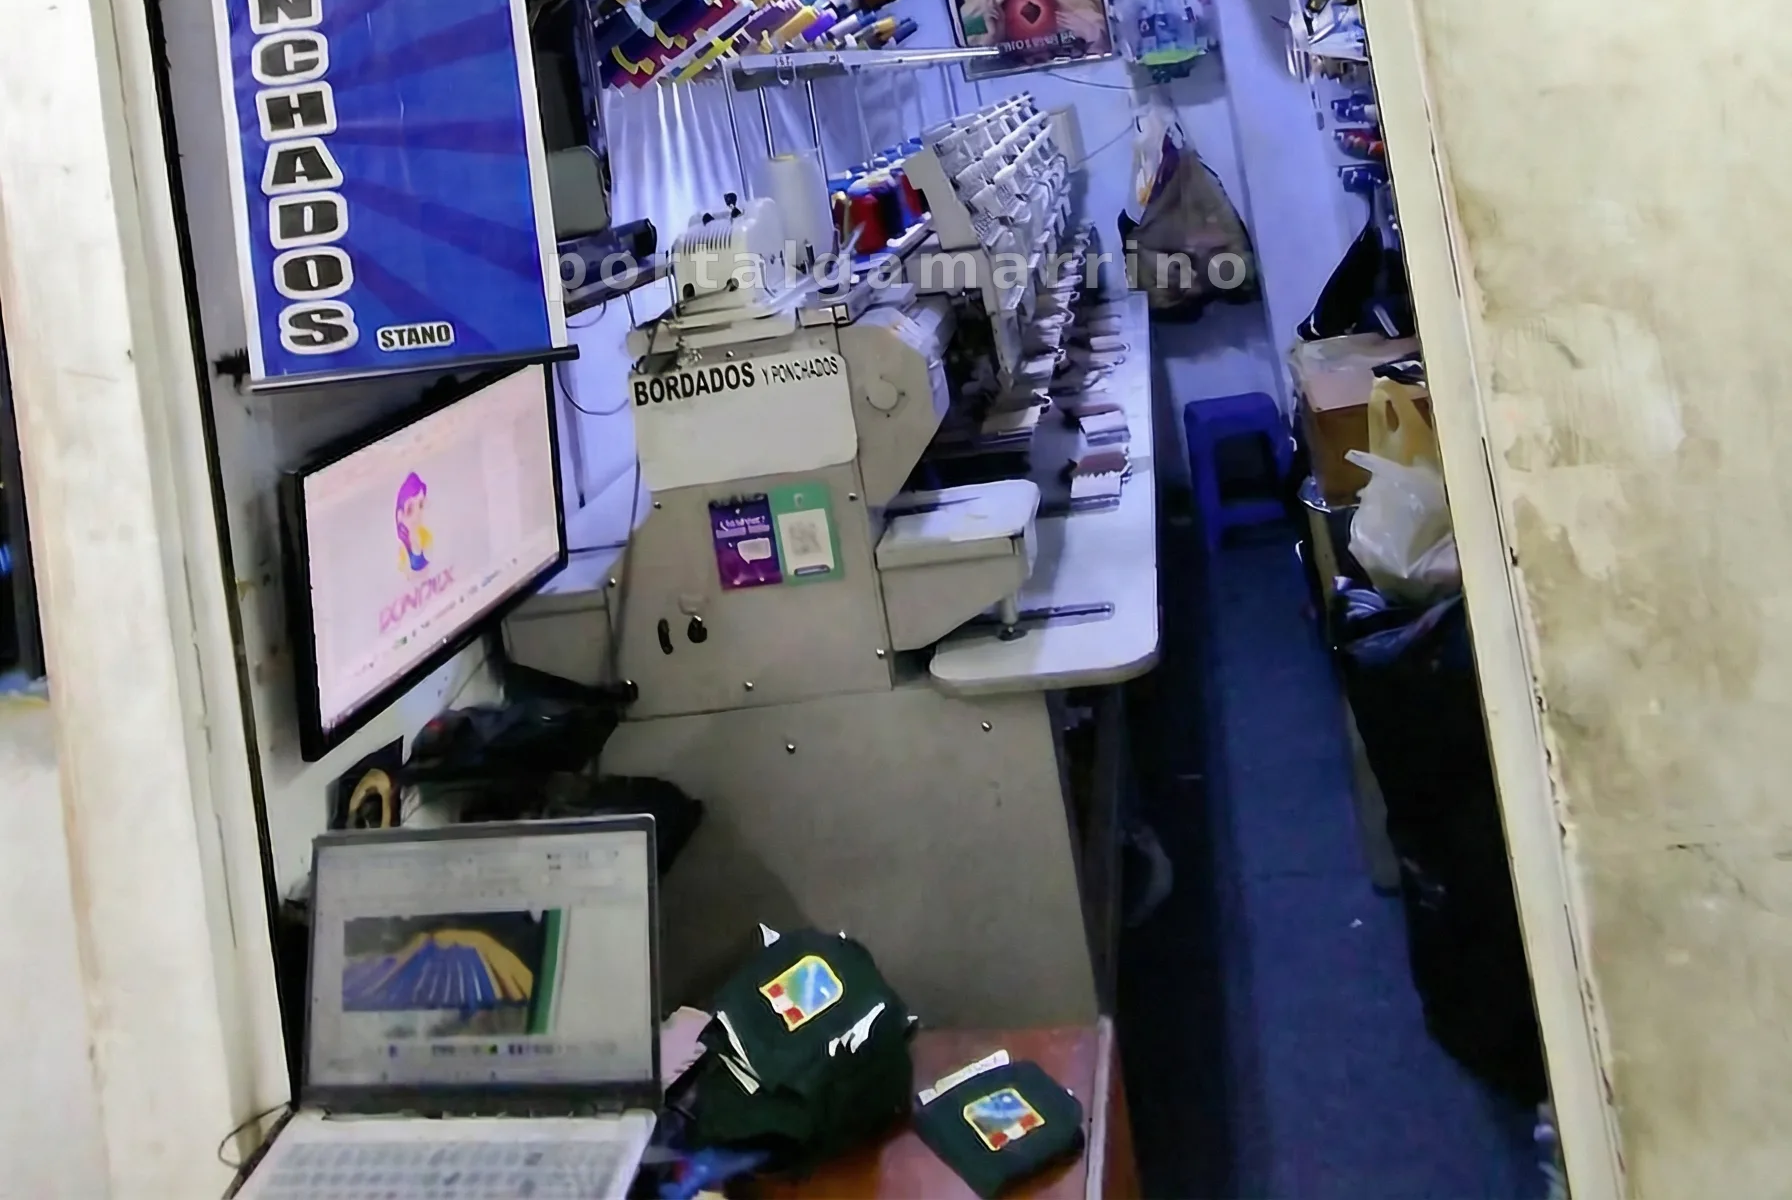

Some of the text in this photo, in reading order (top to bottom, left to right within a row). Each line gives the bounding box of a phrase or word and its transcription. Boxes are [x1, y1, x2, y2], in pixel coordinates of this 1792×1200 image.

[633, 355, 840, 407] BORDADOS Y PONCHADOS
